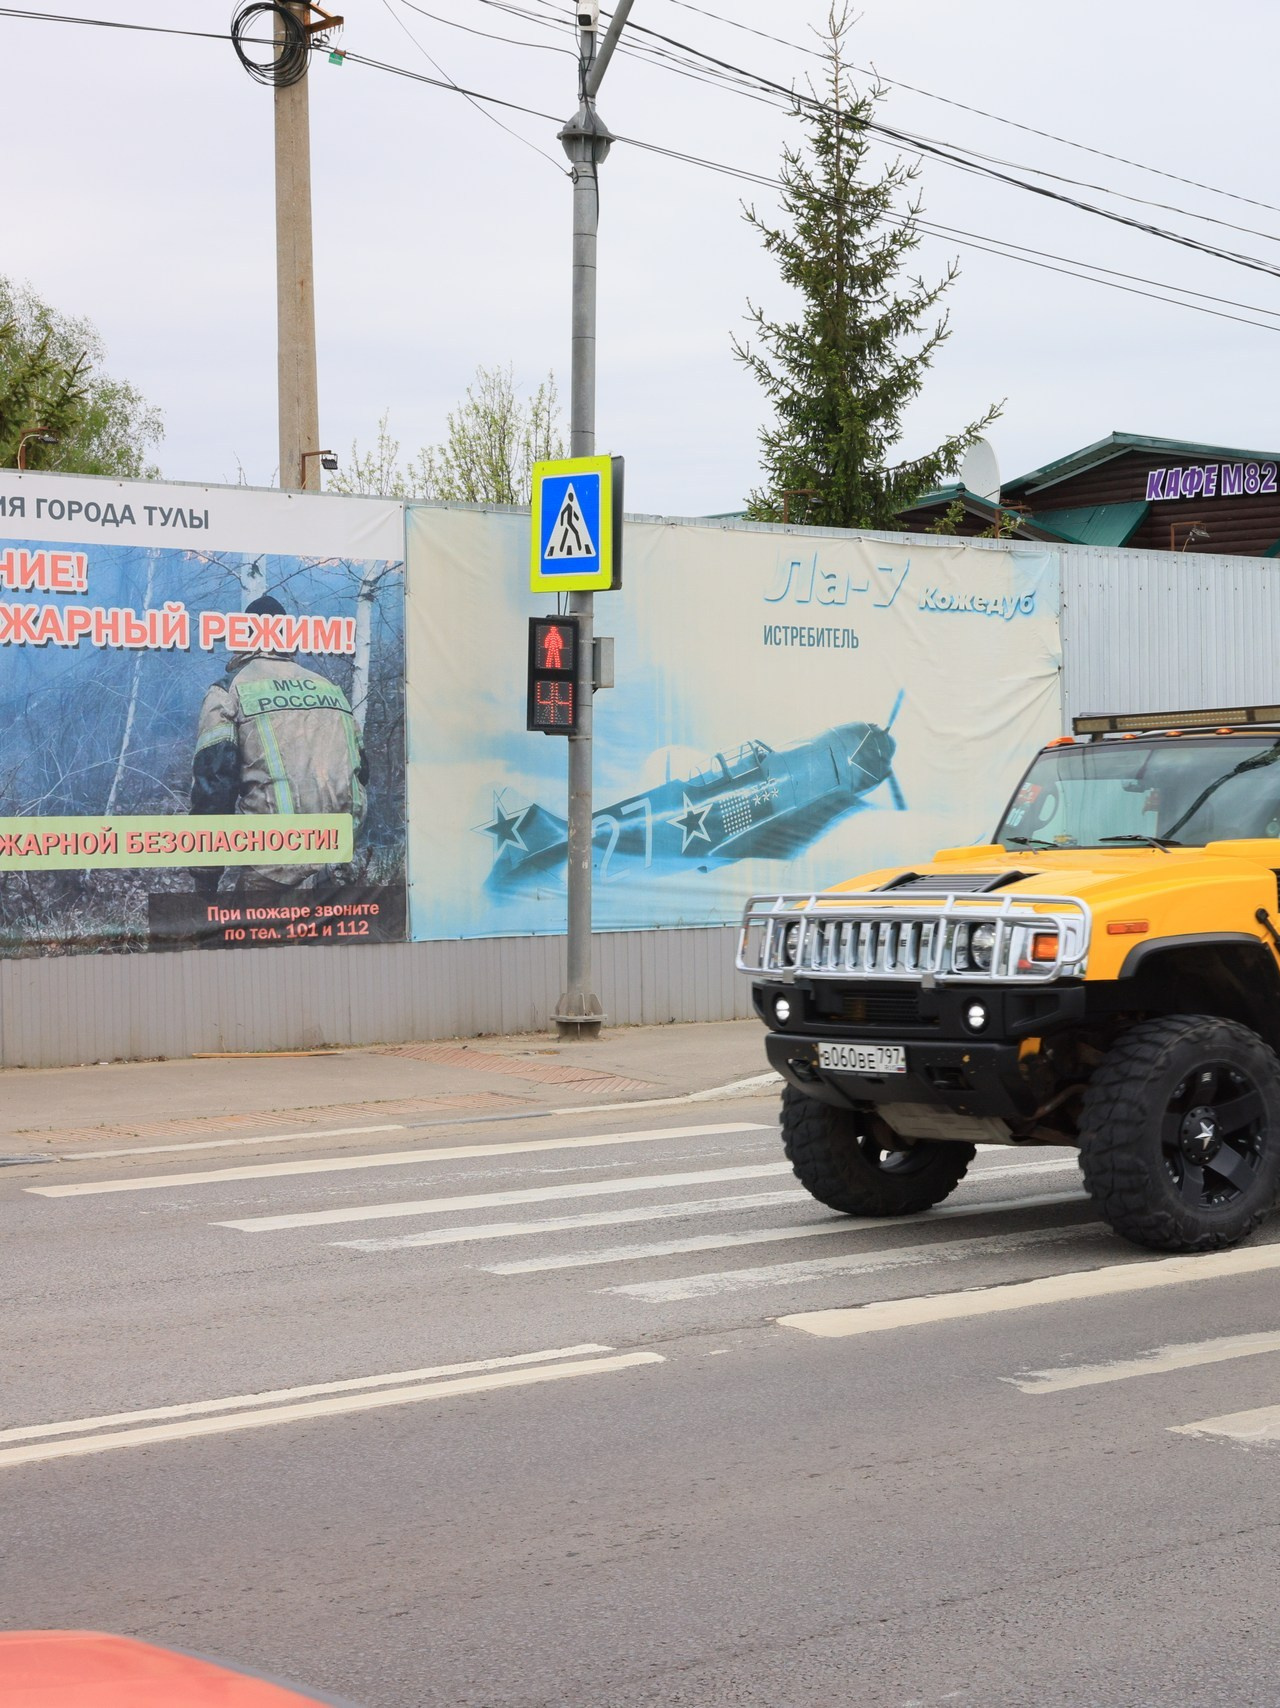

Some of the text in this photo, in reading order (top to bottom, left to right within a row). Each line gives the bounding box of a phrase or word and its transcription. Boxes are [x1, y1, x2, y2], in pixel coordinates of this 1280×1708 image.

[1145, 462, 1278, 501] КАФЕ М82
[36, 497, 137, 528] ГОРОДА
[143, 505, 210, 530] ТУЛЫ
[763, 550, 1036, 621] Ла-7 Кожедуб
[0, 603, 356, 653] ЖАРНЫЙ РЕЖИМ!
[763, 624, 860, 649] ИСТРЕБИТЕЛЬ
[272, 678, 318, 693] МЧС
[257, 694, 344, 712] РОССИИ
[0, 825, 340, 857] ЖАРНОЙ БЕЗОПАСНОСТИ!
[592, 797, 653, 885] 27
[207, 903, 380, 924] При пожаре звоните
[224, 919, 370, 941] по тел. 101 и 112
